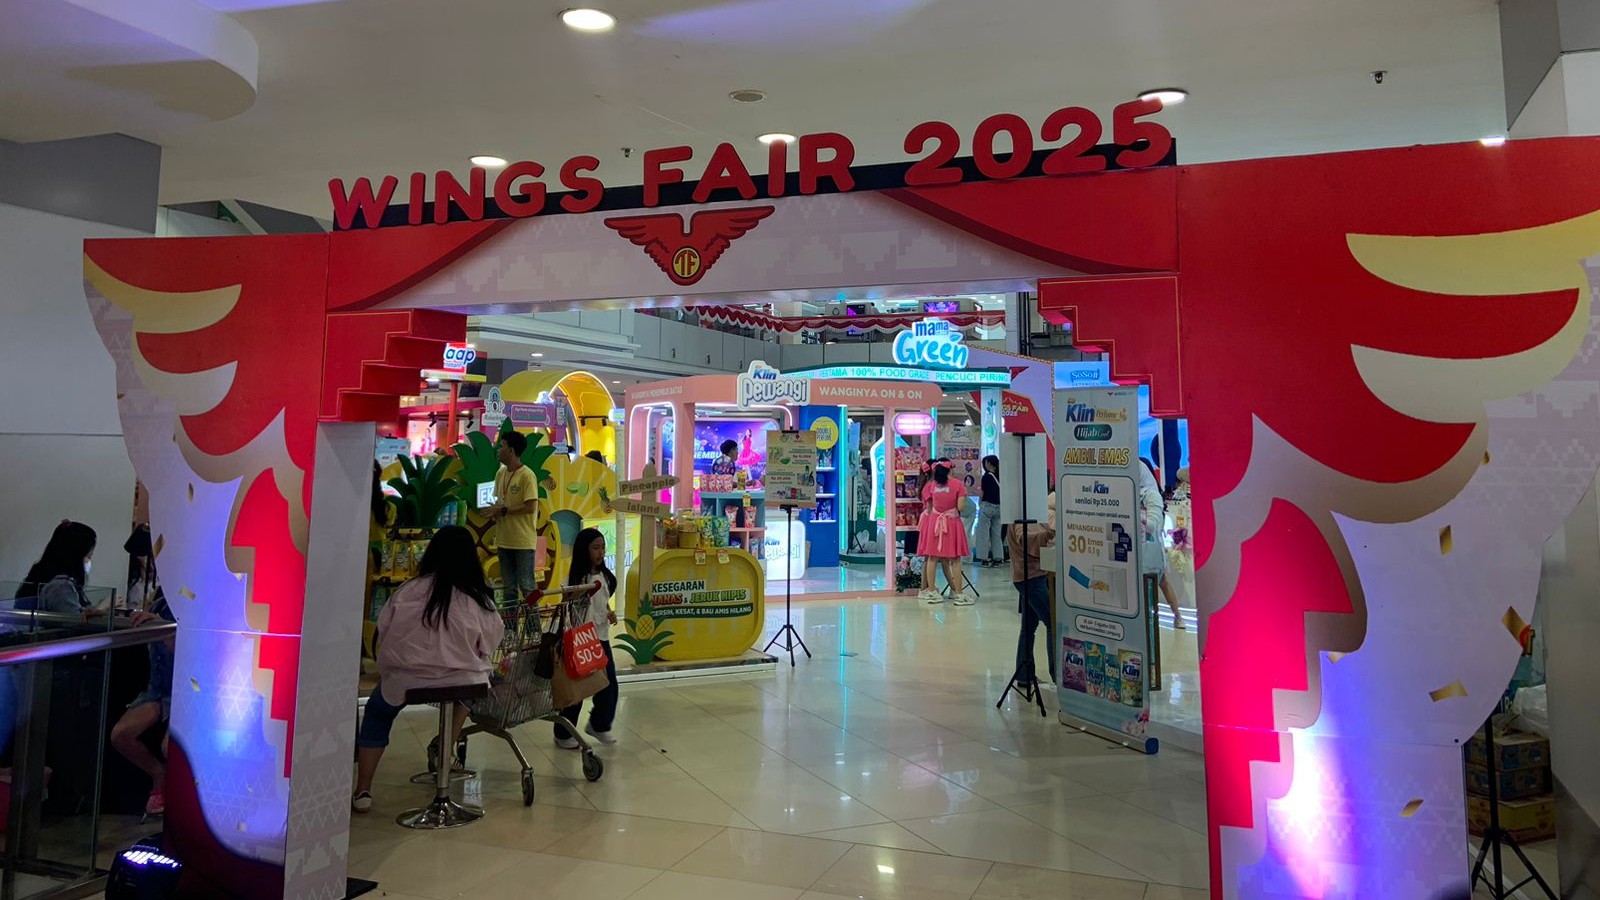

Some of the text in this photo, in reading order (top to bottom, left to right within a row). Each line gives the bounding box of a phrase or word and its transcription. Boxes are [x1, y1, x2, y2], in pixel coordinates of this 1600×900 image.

[328, 97, 1173, 230] WINGS FAIR 2025
[915, 321, 949, 336] mama
[896, 332, 968, 366] Green
[753, 369, 777, 380] Klin
[851, 369, 877, 377] 100%
[879, 369, 906, 378] FOOD
[935, 372, 977, 380] PENCUCI
[979, 373, 1009, 381] PIRING
[819, 386, 878, 397] WANGINYA
[880, 387, 896, 398] ON
[907, 389, 923, 399] ON
[1066, 403, 1095, 423] Klin
[1063, 447, 1130, 466] AMBIL EMAS
[621, 478, 675, 493] Pineapple
[627, 501, 660, 513] Island
[1068, 534, 1087, 554] 30
[652, 580, 705, 593] KESEGARAN
[690, 590, 720, 603] JERUK
[721, 589, 747, 601] NIPIS
[573, 627, 598, 647] MINI
[1066, 653, 1083, 665] Klin
[1122, 664, 1140, 678] Klin
